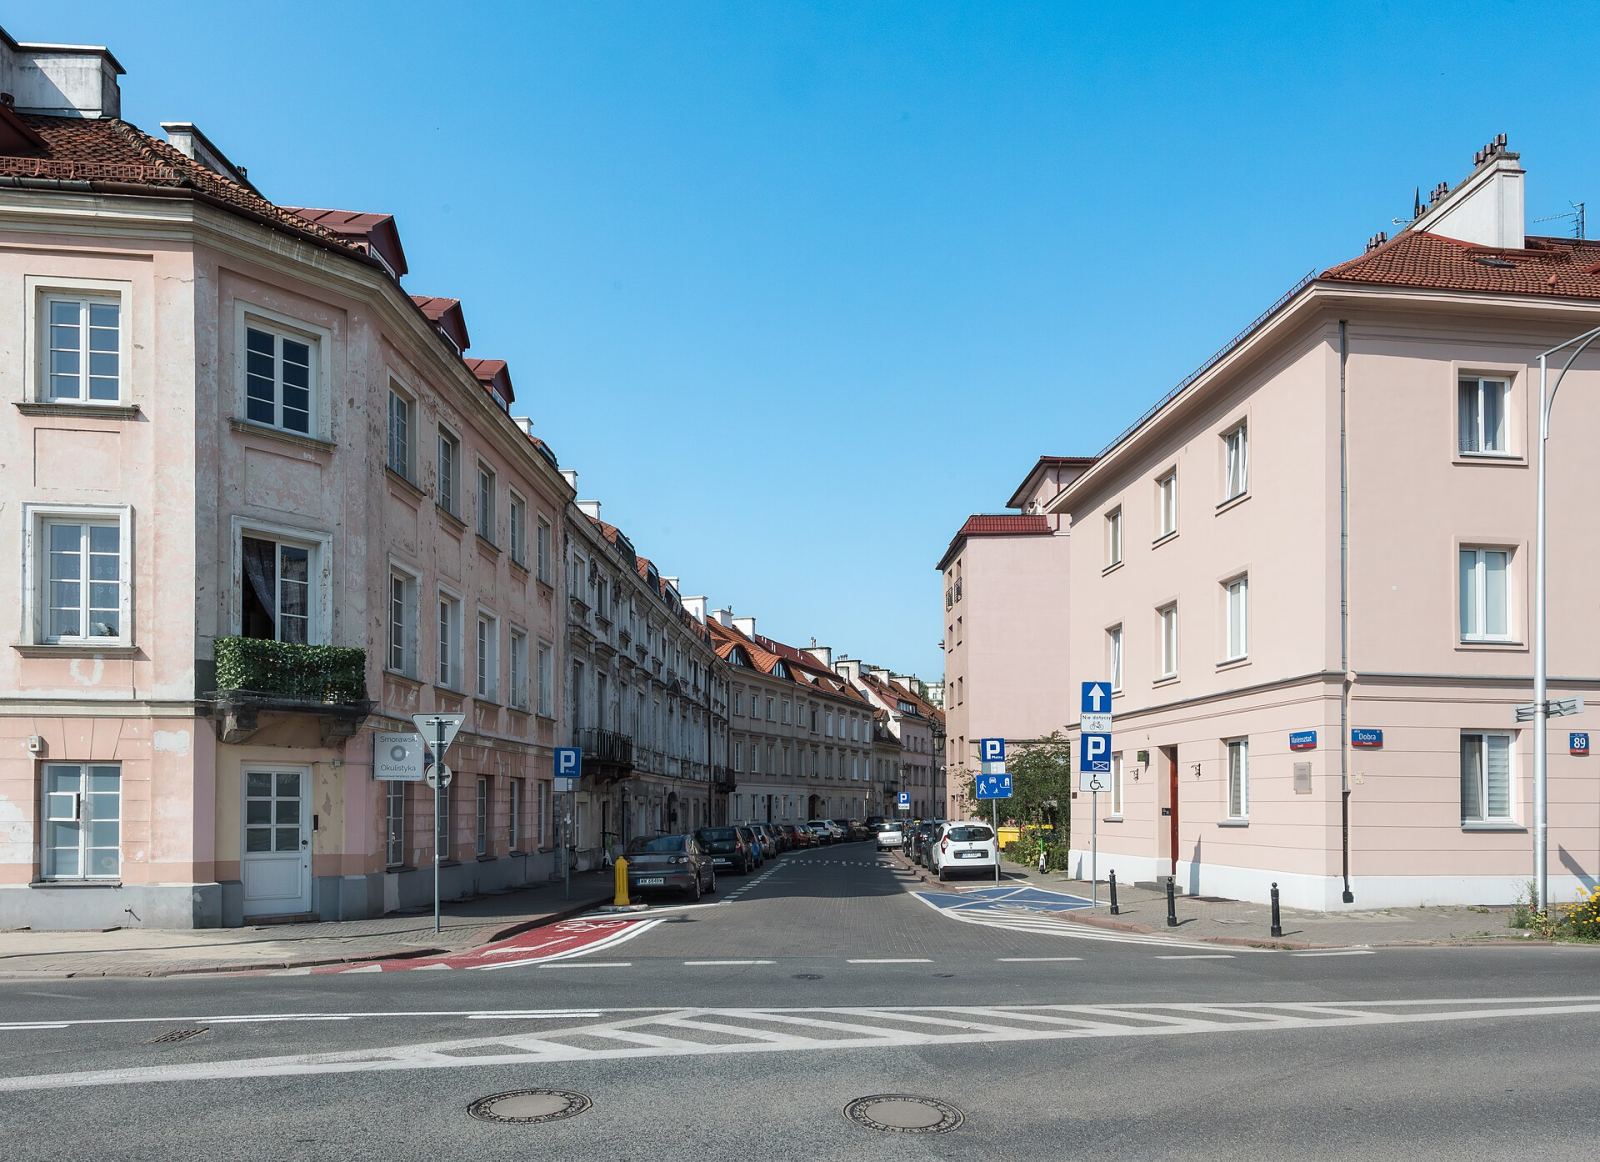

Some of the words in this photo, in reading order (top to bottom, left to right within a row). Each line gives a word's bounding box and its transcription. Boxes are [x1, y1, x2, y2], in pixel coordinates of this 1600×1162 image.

[1358, 732, 1377, 741] Dobra
[1573, 737, 1586, 749] 89
[986, 740, 1001, 760] P
[1087, 736, 1106, 761] P
[560, 750, 576, 774] P
[900, 793, 908, 803] P
